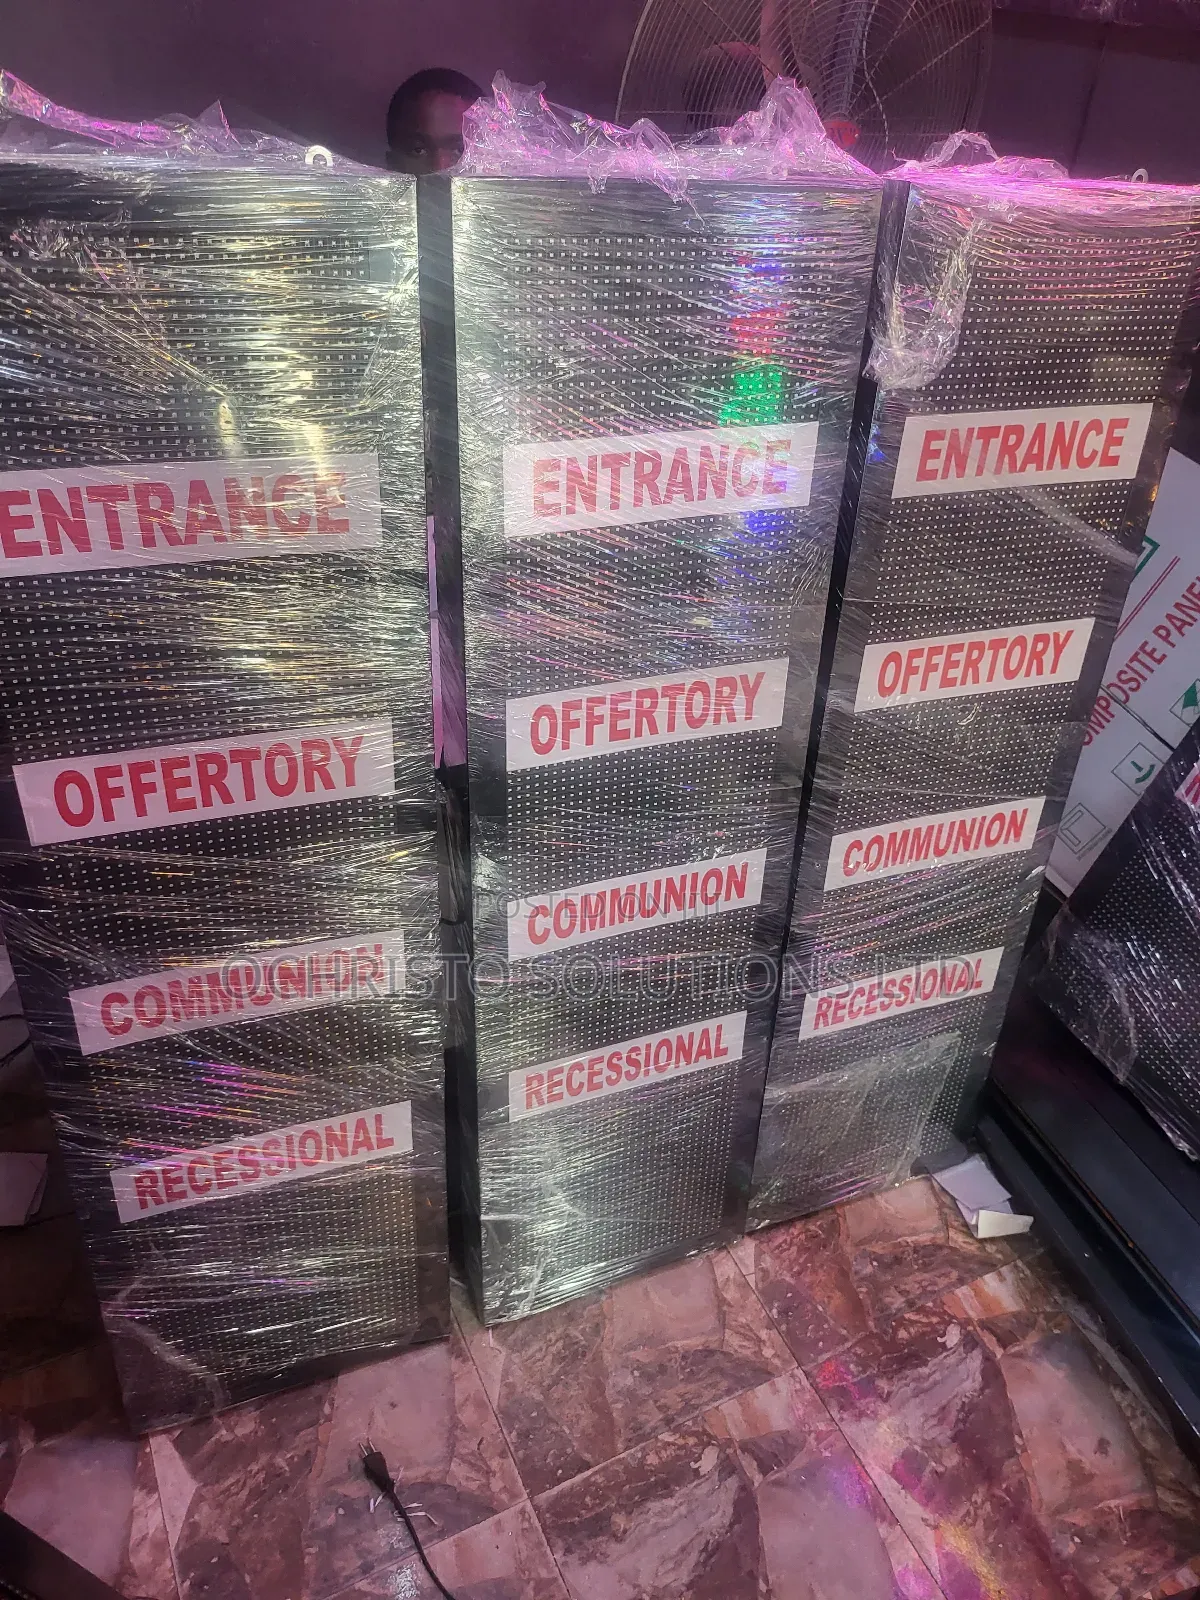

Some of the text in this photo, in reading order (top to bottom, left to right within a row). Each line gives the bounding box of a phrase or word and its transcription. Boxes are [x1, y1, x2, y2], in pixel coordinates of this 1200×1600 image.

[532, 438, 792, 518] ENTRANCE
[915, 417, 1131, 482] ENTRANCE
[0, 472, 351, 559] ENTRANCE
[1152, 575, 1200, 638] PANE
[877, 629, 1075, 699] OFFERTORY
[530, 671, 766, 756] OFFERTORY
[52, 735, 364, 828] OFFERTORY
[842, 807, 1029, 877] COMMUNION
[527, 861, 749, 946] COMMUNION
[100, 944, 385, 1036] COMMUNION
[813, 958, 983, 1030] RECESSIONAL
[525, 1024, 729, 1110] RECESSIONAL
[134, 1114, 394, 1210] RECESSIONAL
